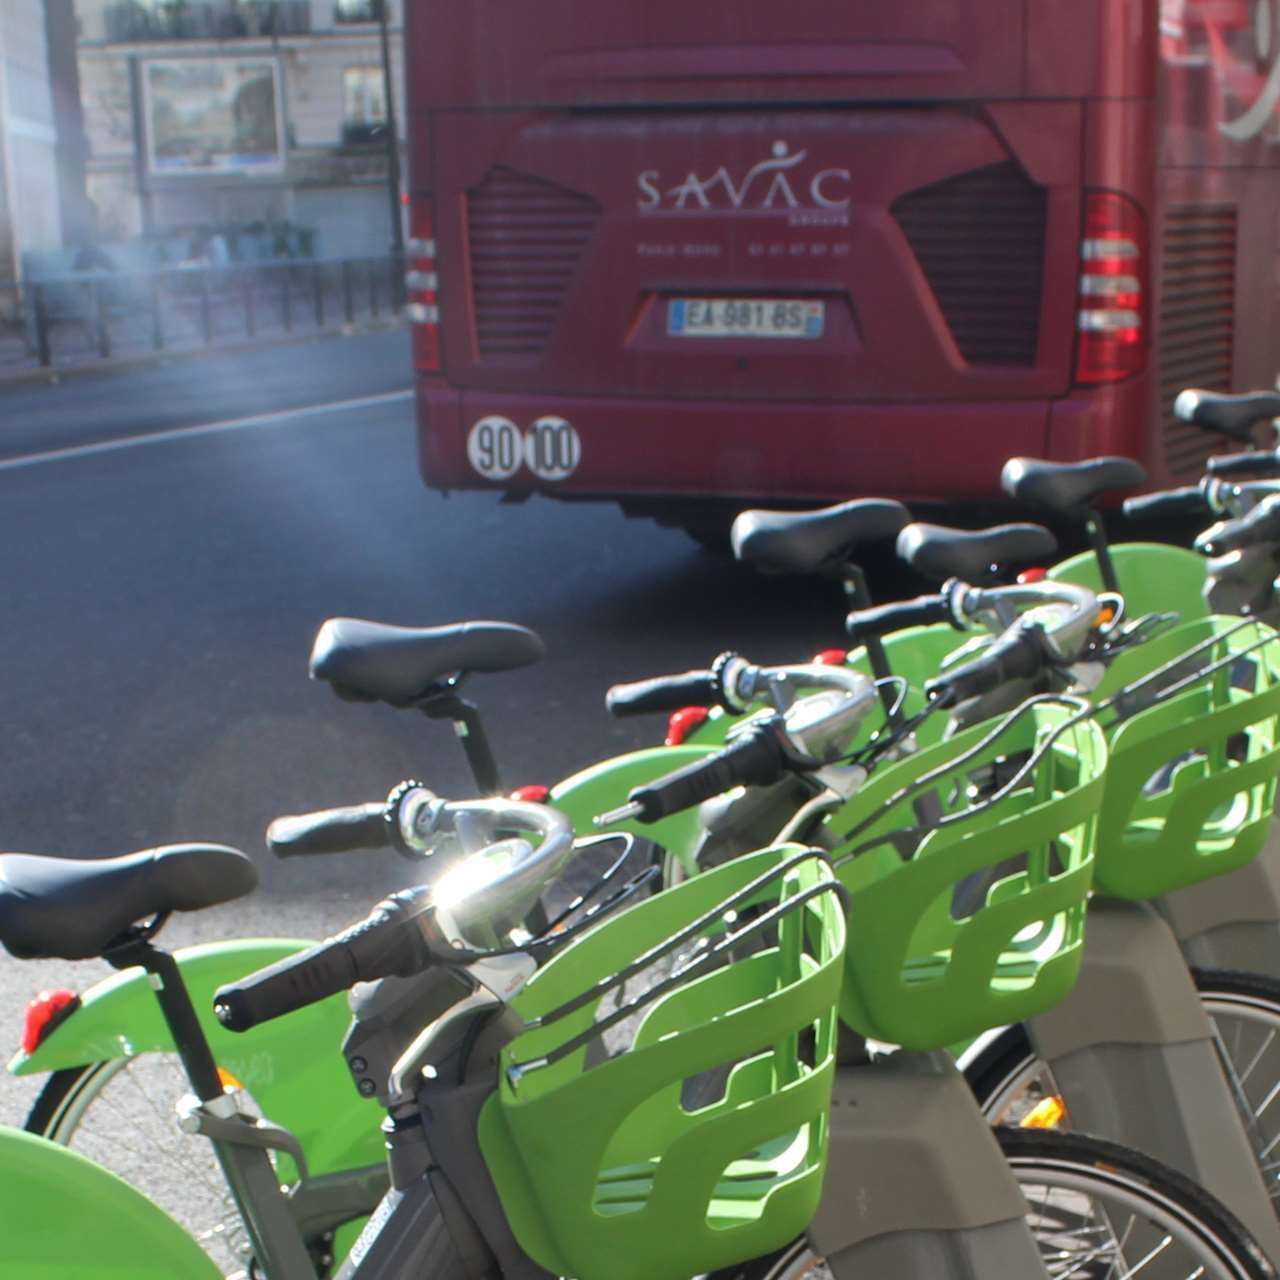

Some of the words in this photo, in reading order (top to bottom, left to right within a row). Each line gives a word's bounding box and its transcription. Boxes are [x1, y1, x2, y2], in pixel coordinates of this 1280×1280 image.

[637, 146, 851, 209] SAVAC
[478, 425, 513, 470] 90
[528, 425, 574, 470] 100
